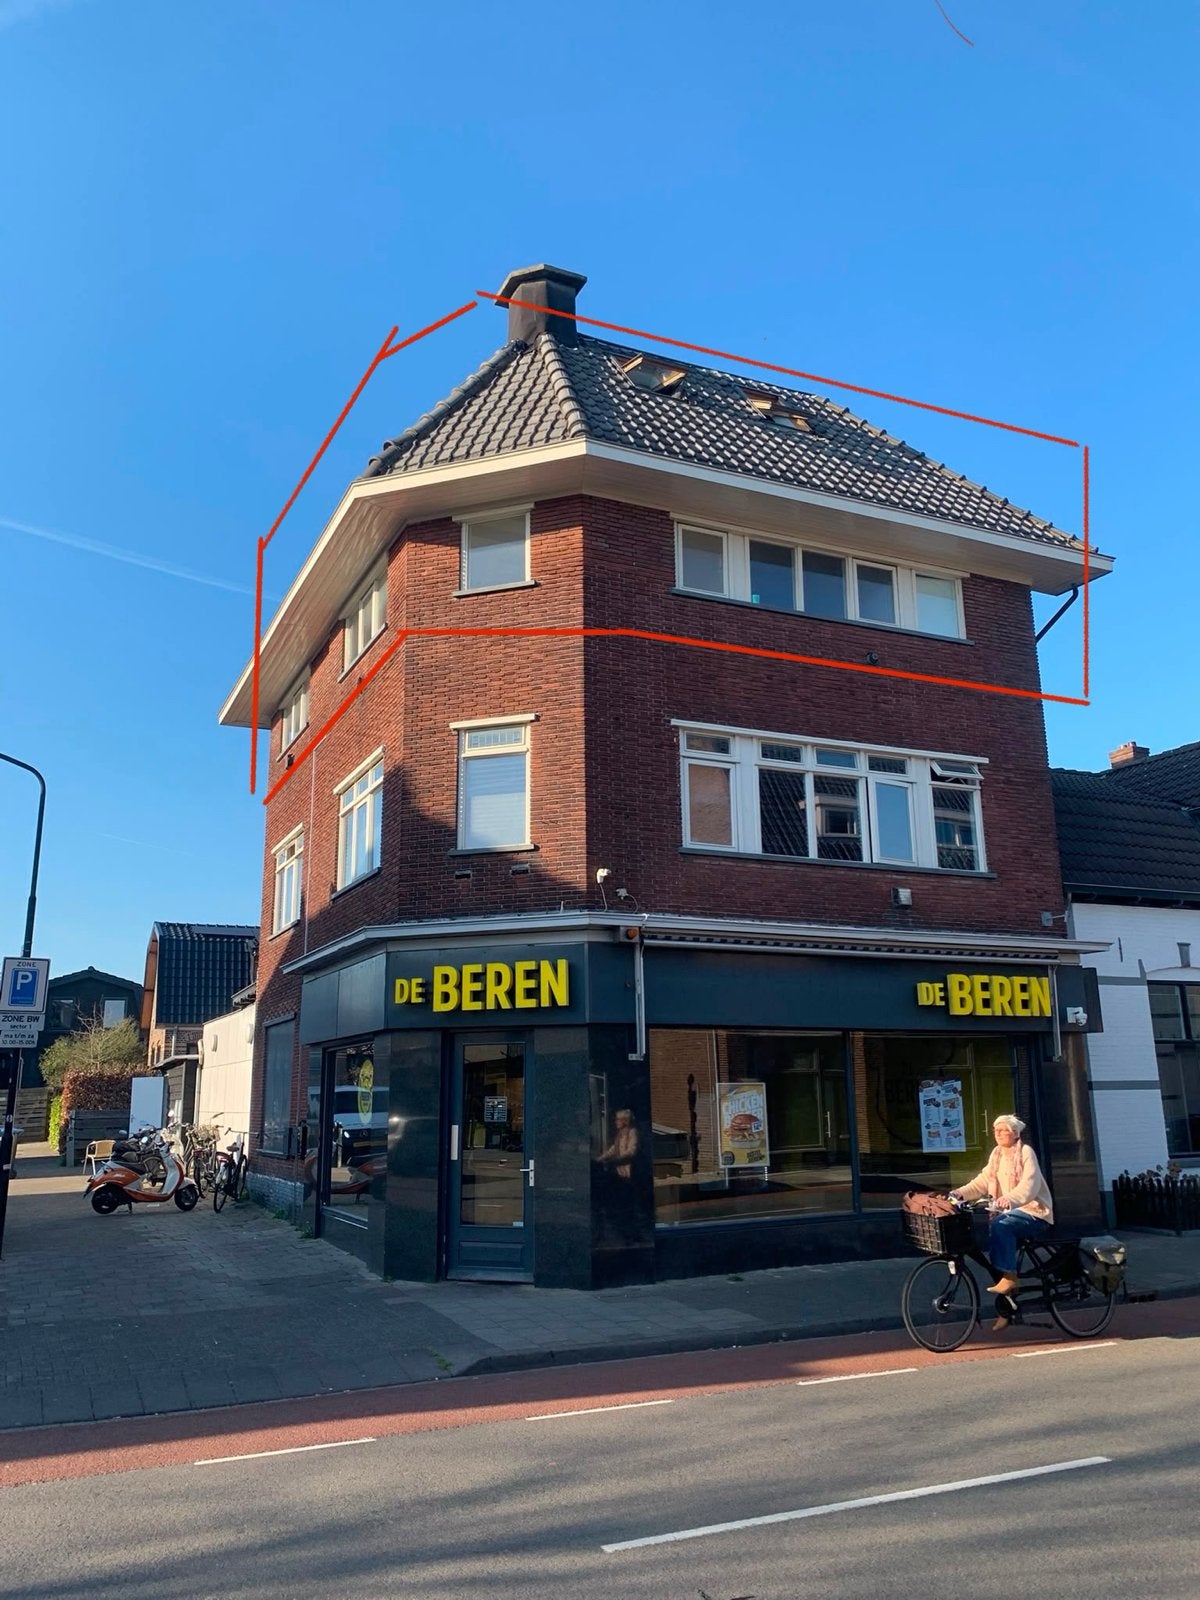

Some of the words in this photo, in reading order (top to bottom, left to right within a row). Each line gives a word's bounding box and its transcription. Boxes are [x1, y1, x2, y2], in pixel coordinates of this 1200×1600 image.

[16, 971, 33, 991] P
[394, 978, 424, 1004] DE
[432, 958, 569, 1012] BEREN
[917, 982, 945, 1006] DE
[947, 974, 1051, 1017] BEREN
[26, 1015, 40, 1023] BW
[722, 1092, 764, 1115] CHICKEN
